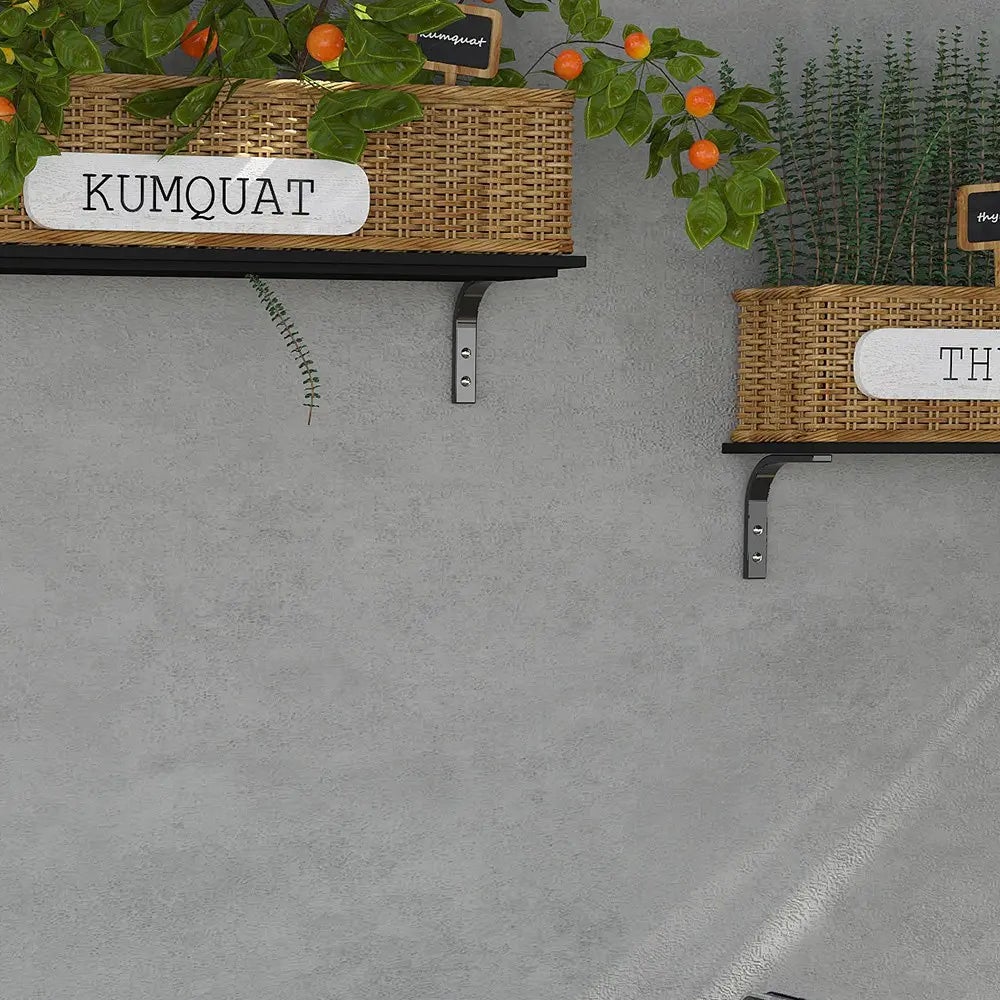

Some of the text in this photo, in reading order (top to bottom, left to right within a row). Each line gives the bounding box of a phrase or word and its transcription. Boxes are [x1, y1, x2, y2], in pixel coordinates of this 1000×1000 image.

[82, 173, 315, 221] KUMQUAT
[976, 211, 1000, 223] thy
[939, 346, 1000, 381] TH
